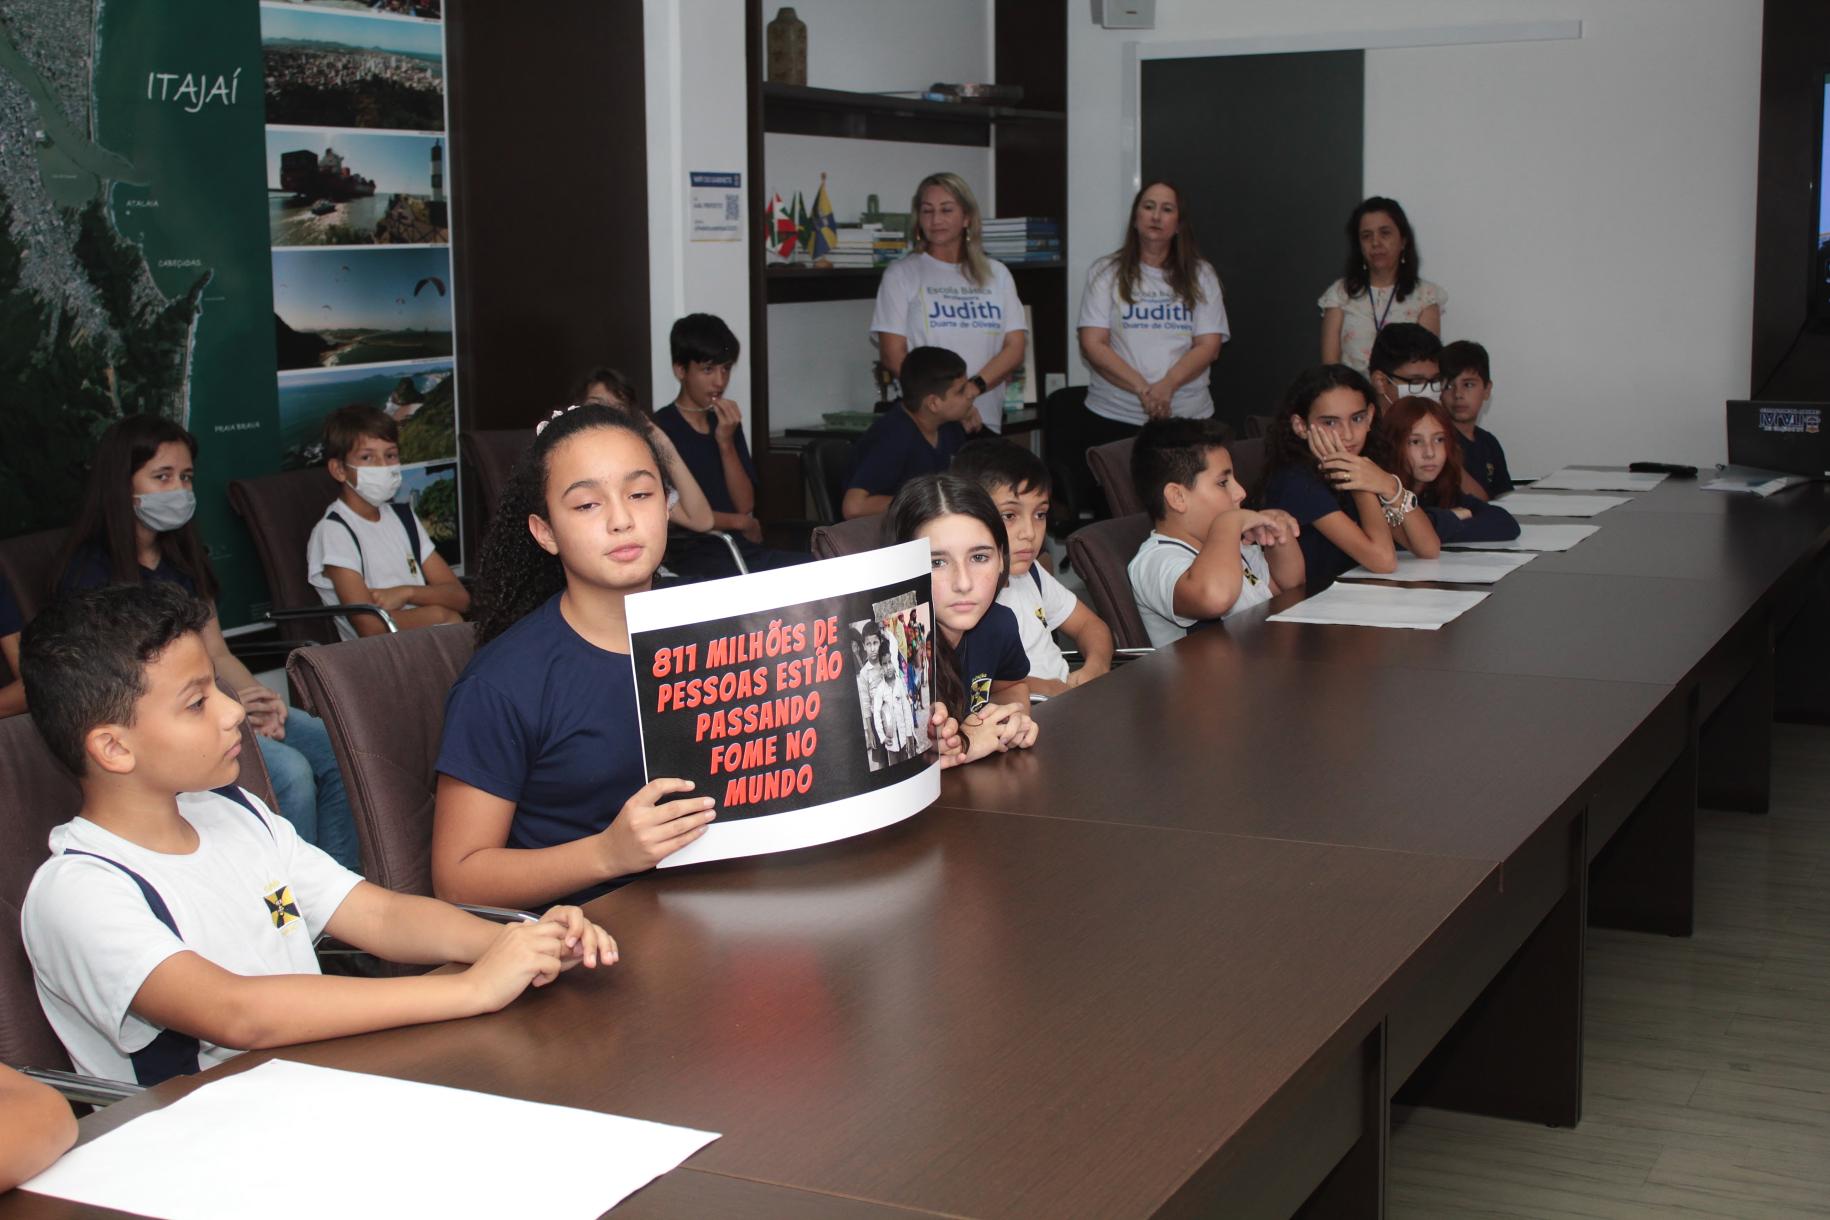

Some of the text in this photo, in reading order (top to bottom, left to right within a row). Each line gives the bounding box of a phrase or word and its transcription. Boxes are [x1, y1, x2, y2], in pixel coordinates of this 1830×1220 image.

[147, 67, 242, 113] ITAJAÍ
[126, 200, 159, 208] ATALAIA
[927, 287, 958, 295] Escola
[929, 301, 1002, 320] Judith
[930, 320, 957, 328] Duarte
[1122, 303, 1193, 321] Judith
[214, 420, 260, 433] PRAIA BRAVA
[652, 615, 838, 678] 811 MILHÕES DE
[657, 644, 843, 713] PESSOAS ESTÃO
[695, 690, 821, 742] PASSANDO
[710, 727, 817, 775] FOME NO
[723, 763, 813, 808] MUNDO
